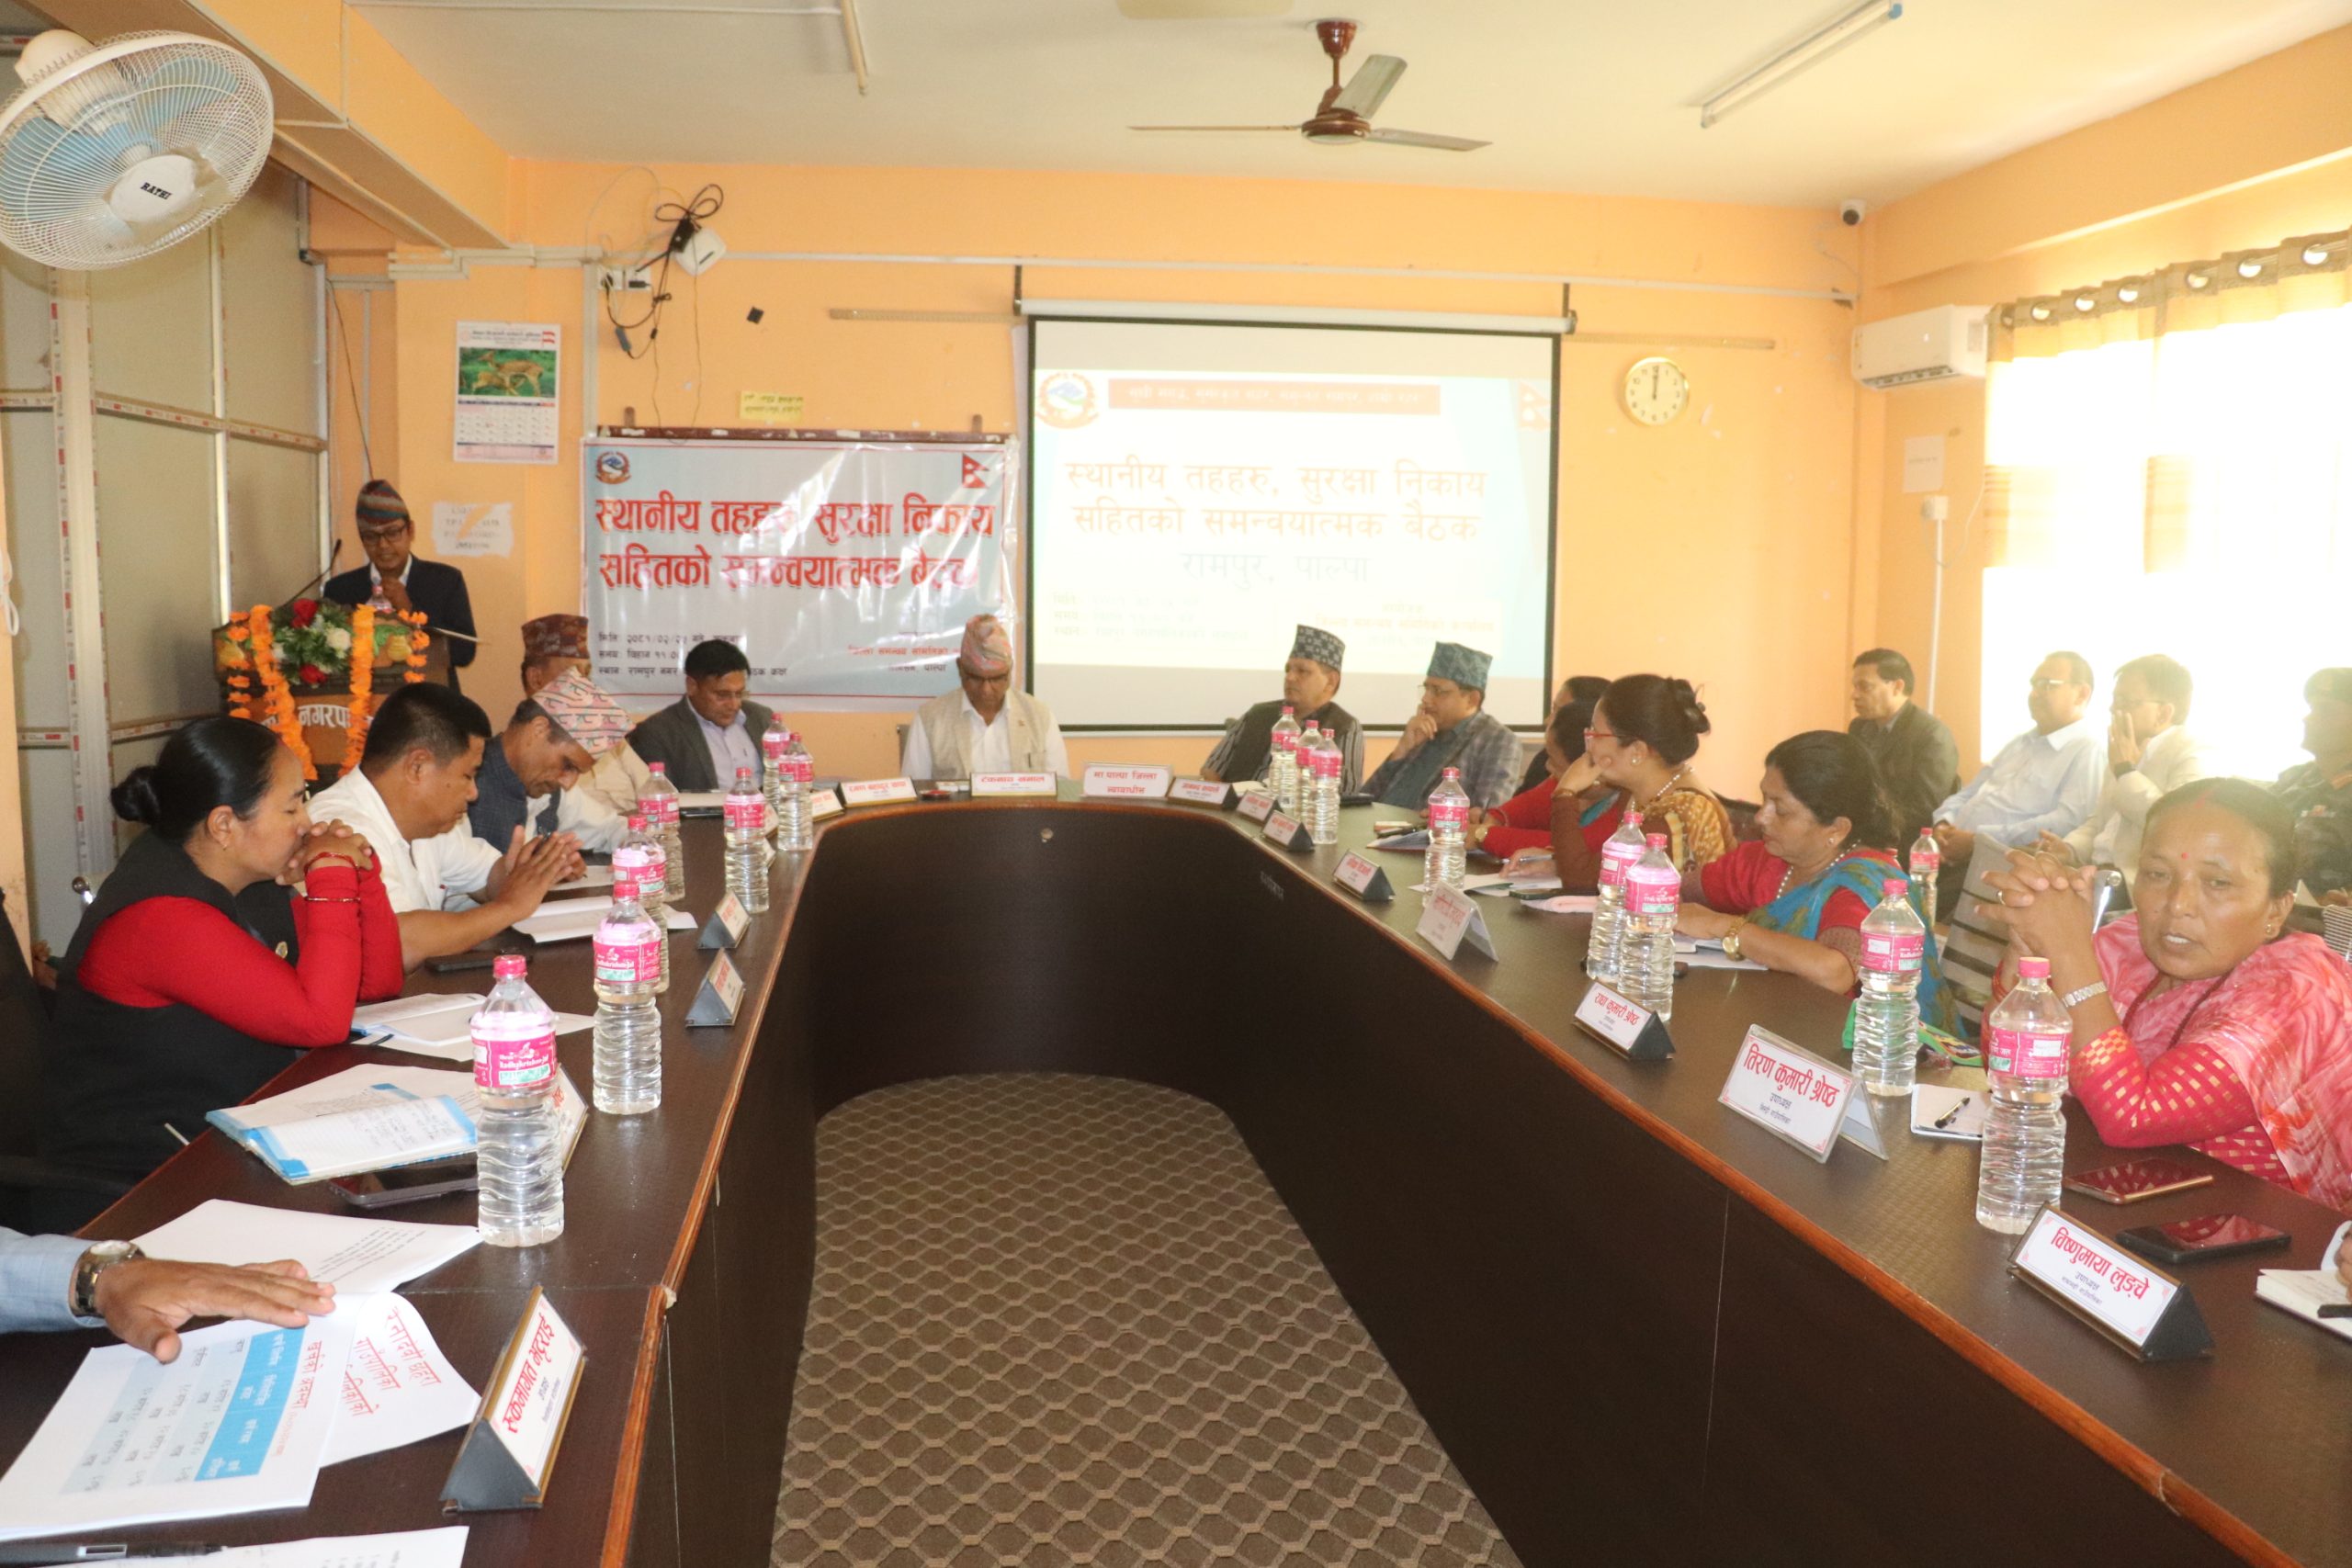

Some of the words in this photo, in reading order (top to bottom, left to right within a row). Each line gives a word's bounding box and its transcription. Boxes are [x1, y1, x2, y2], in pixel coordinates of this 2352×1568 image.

[140, 182, 173, 200] RATHI
[1395, 458, 1488, 498] निकाय
[595, 490, 701, 534] स्थानीय
[815, 502, 893, 544] सुरक्षा
[1069, 494, 1186, 536] सहितको
[1401, 501, 1483, 542] बैठक
[599, 544, 712, 591] सहितको
[1774, 1063, 1814, 1096] कुमारी
[1809, 1075, 1840, 1108] श्रेष्ठ
[2051, 1226, 2113, 1277] विष्णुमाया
